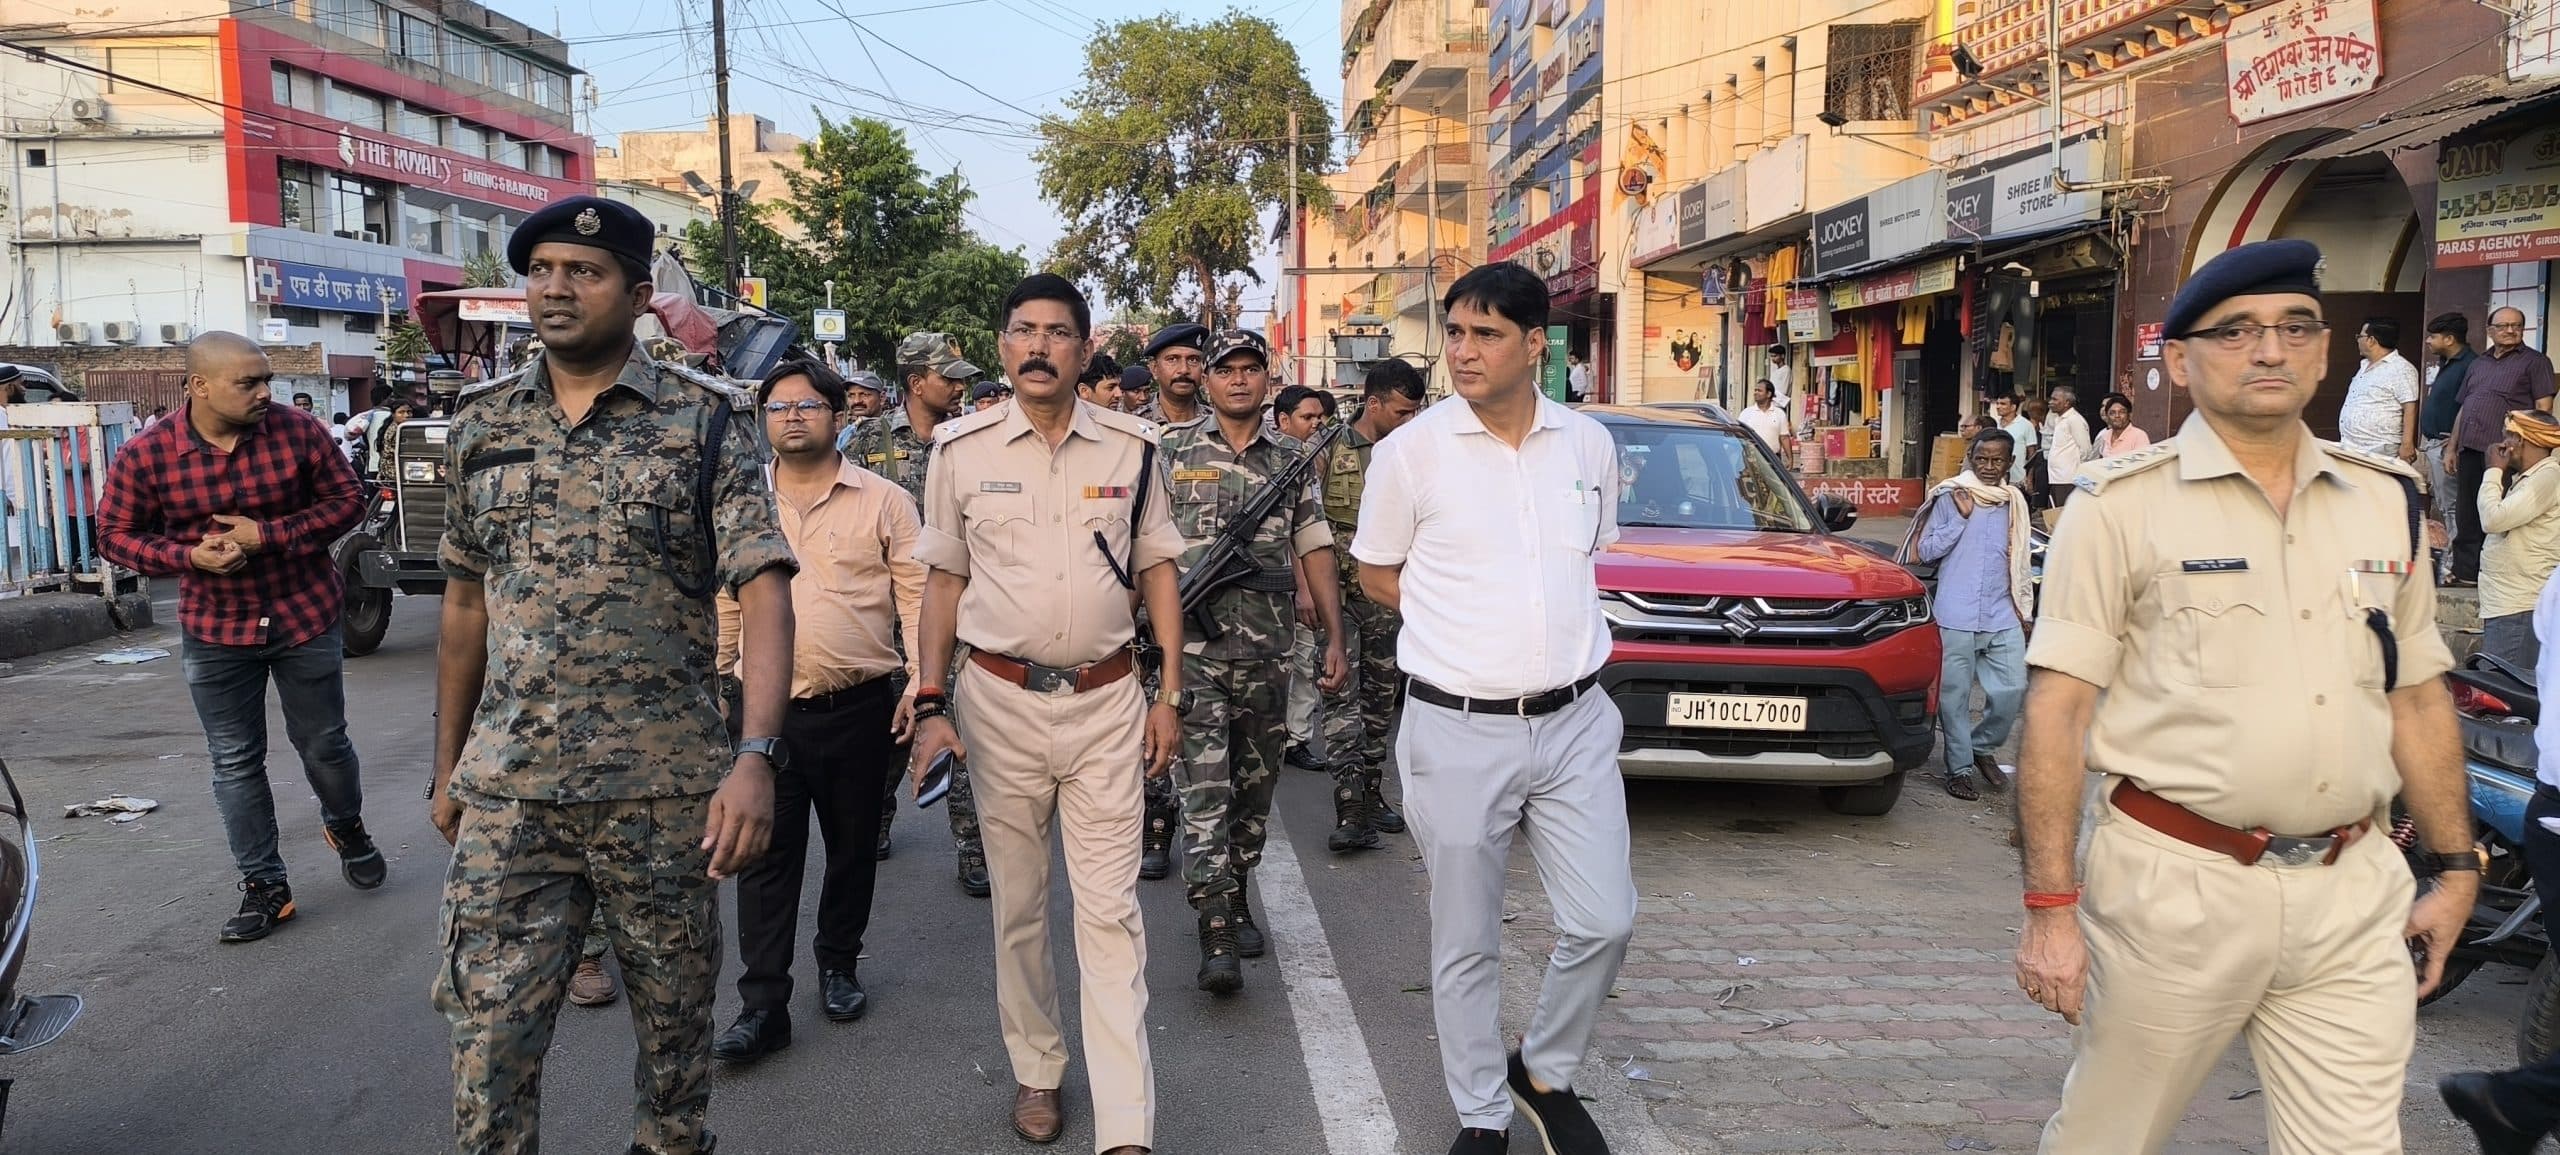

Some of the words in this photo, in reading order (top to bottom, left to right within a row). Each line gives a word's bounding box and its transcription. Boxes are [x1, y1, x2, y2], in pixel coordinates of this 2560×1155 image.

[2233, 70, 2257, 100] श्री
[357, 139, 391, 168] THE
[2440, 140, 2506, 182] JAIN
[2007, 177, 2041, 201] SHREE
[1681, 199, 1705, 221] JOCKEY
[1946, 193, 1981, 220] CKEY
[2019, 194, 2054, 216] STORE
[1820, 212, 1864, 246] JOCKEY
[2437, 239, 2476, 256] PARAS
[2477, 233, 2532, 252] AGENCY,
[289, 275, 310, 299] एच
[313, 271, 329, 298] डी
[331, 279, 353, 303] एफ
[354, 276, 371, 303] सी
[1866, 482, 1901, 505] स्टोर
[1683, 700, 1801, 724] JH10CL7000
